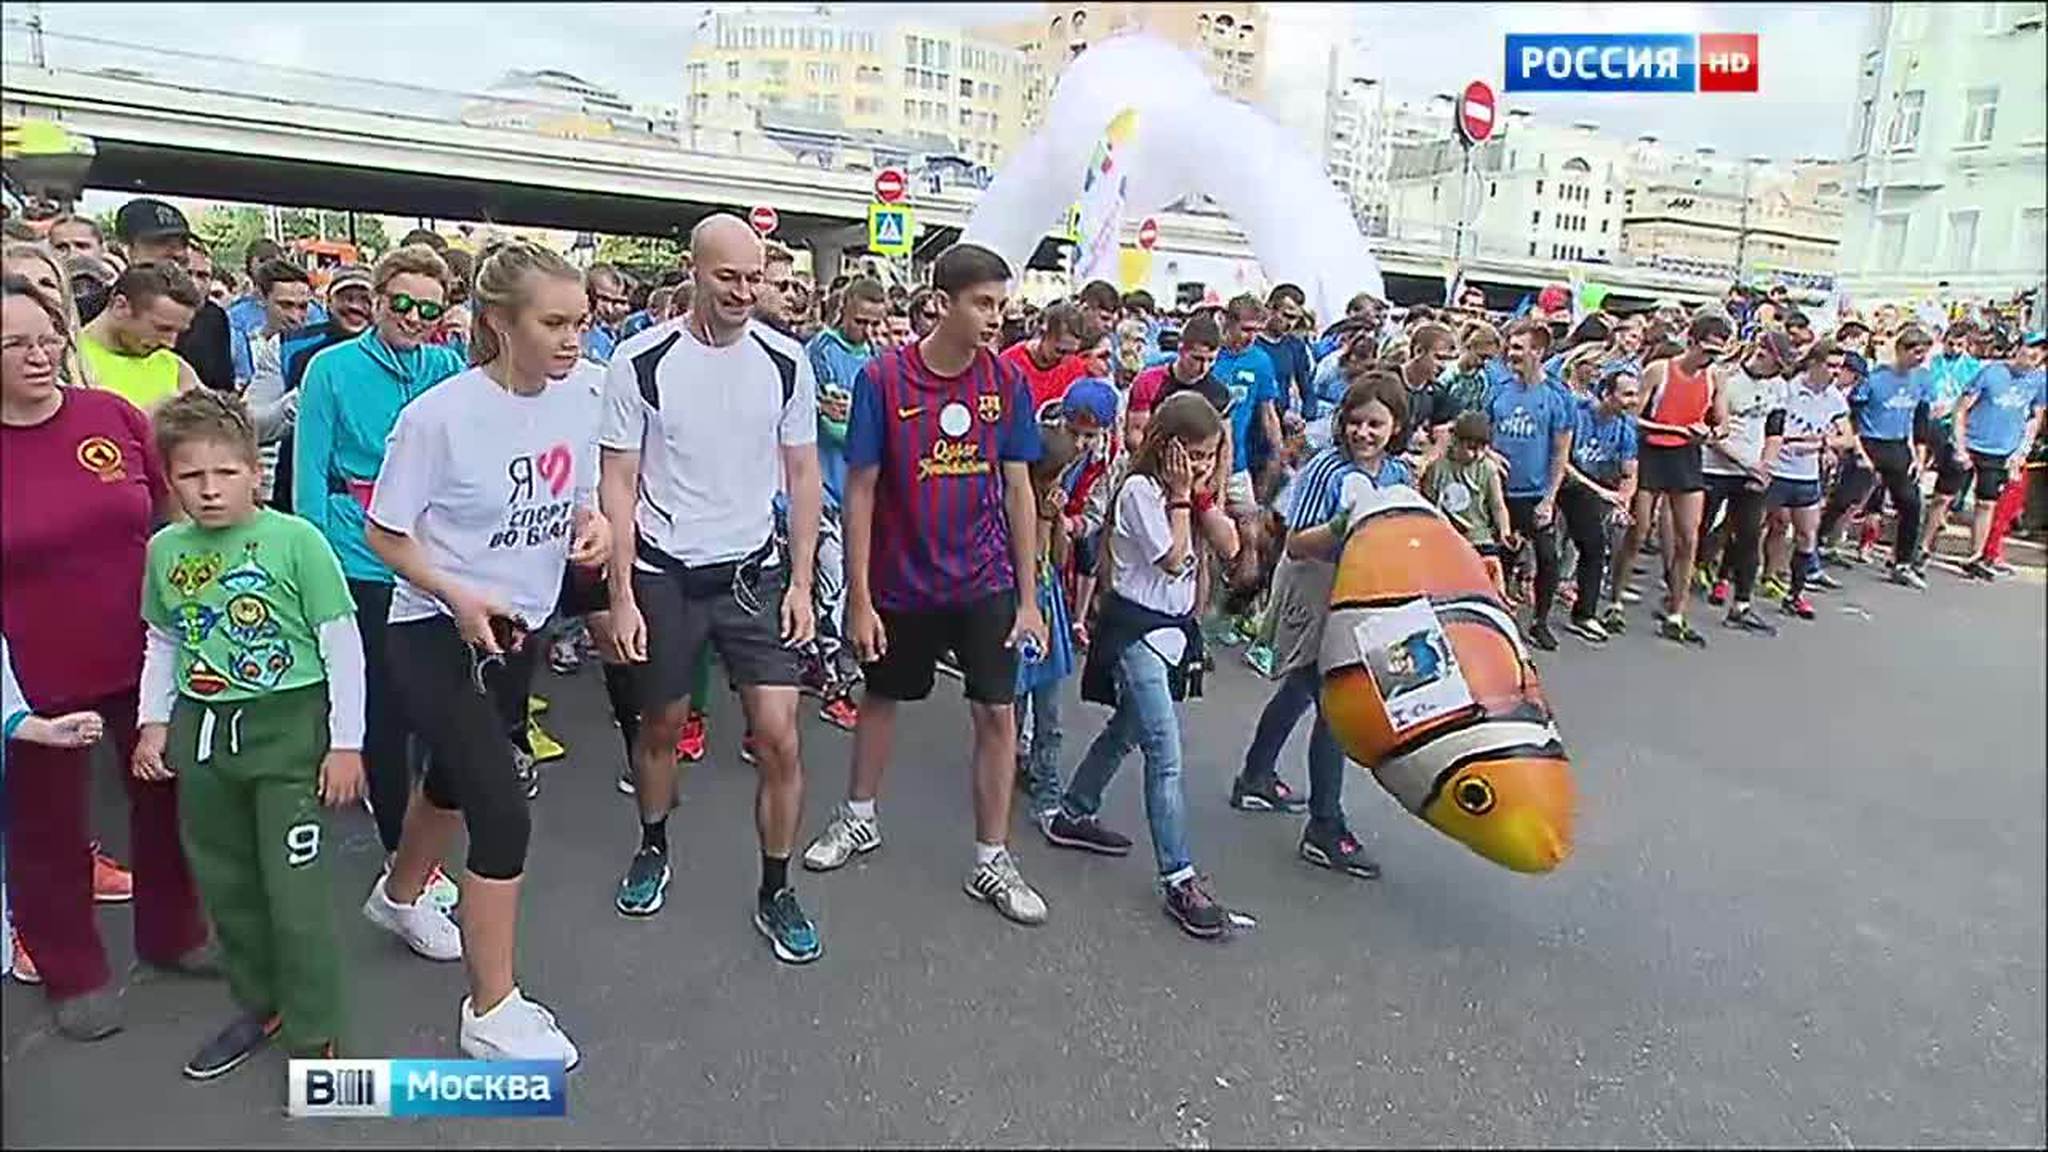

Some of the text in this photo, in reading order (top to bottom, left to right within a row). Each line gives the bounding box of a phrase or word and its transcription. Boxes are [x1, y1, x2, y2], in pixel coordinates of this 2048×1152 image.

[508, 455, 534, 503] Я
[508, 500, 571, 528] СПОРТ
[287, 823, 320, 865] 9
